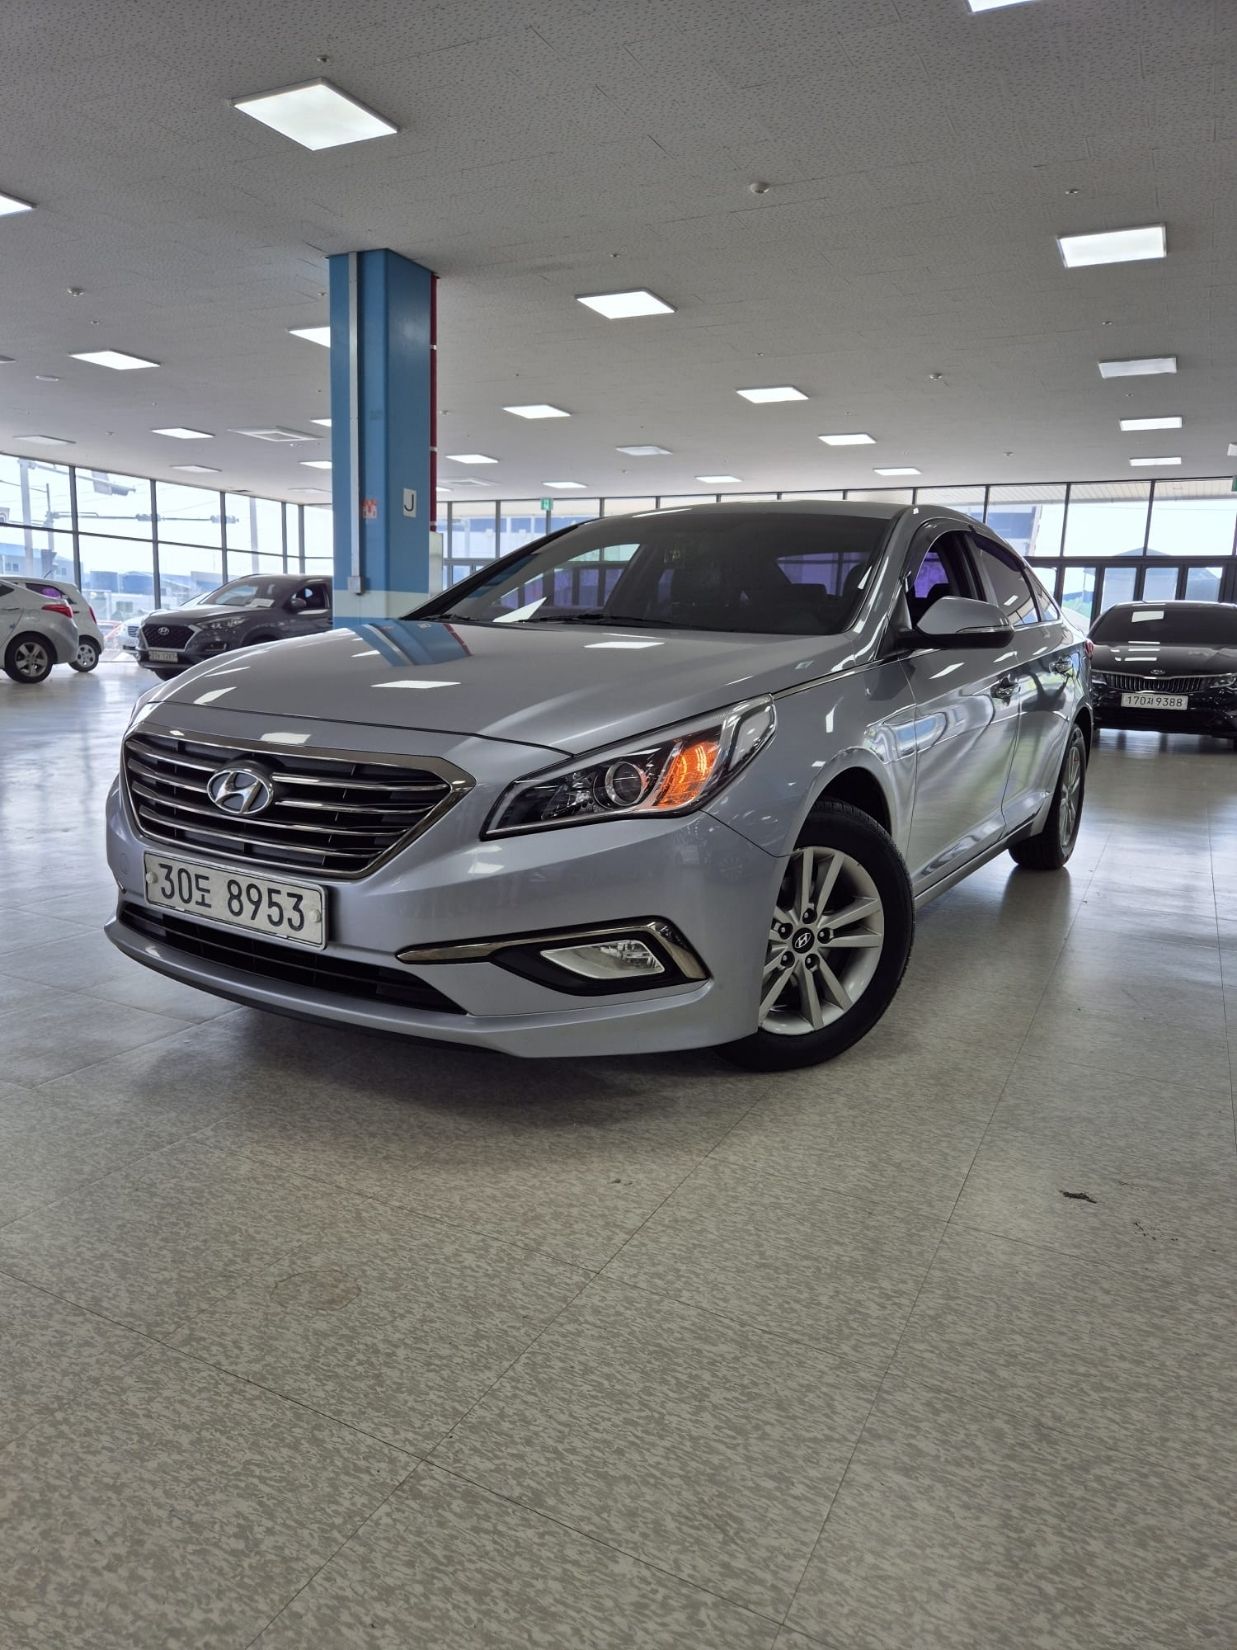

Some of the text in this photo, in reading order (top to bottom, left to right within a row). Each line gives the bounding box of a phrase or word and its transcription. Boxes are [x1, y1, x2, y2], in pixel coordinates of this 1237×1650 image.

[404, 494, 415, 511] J
[158, 863, 306, 932] 30도 8953
